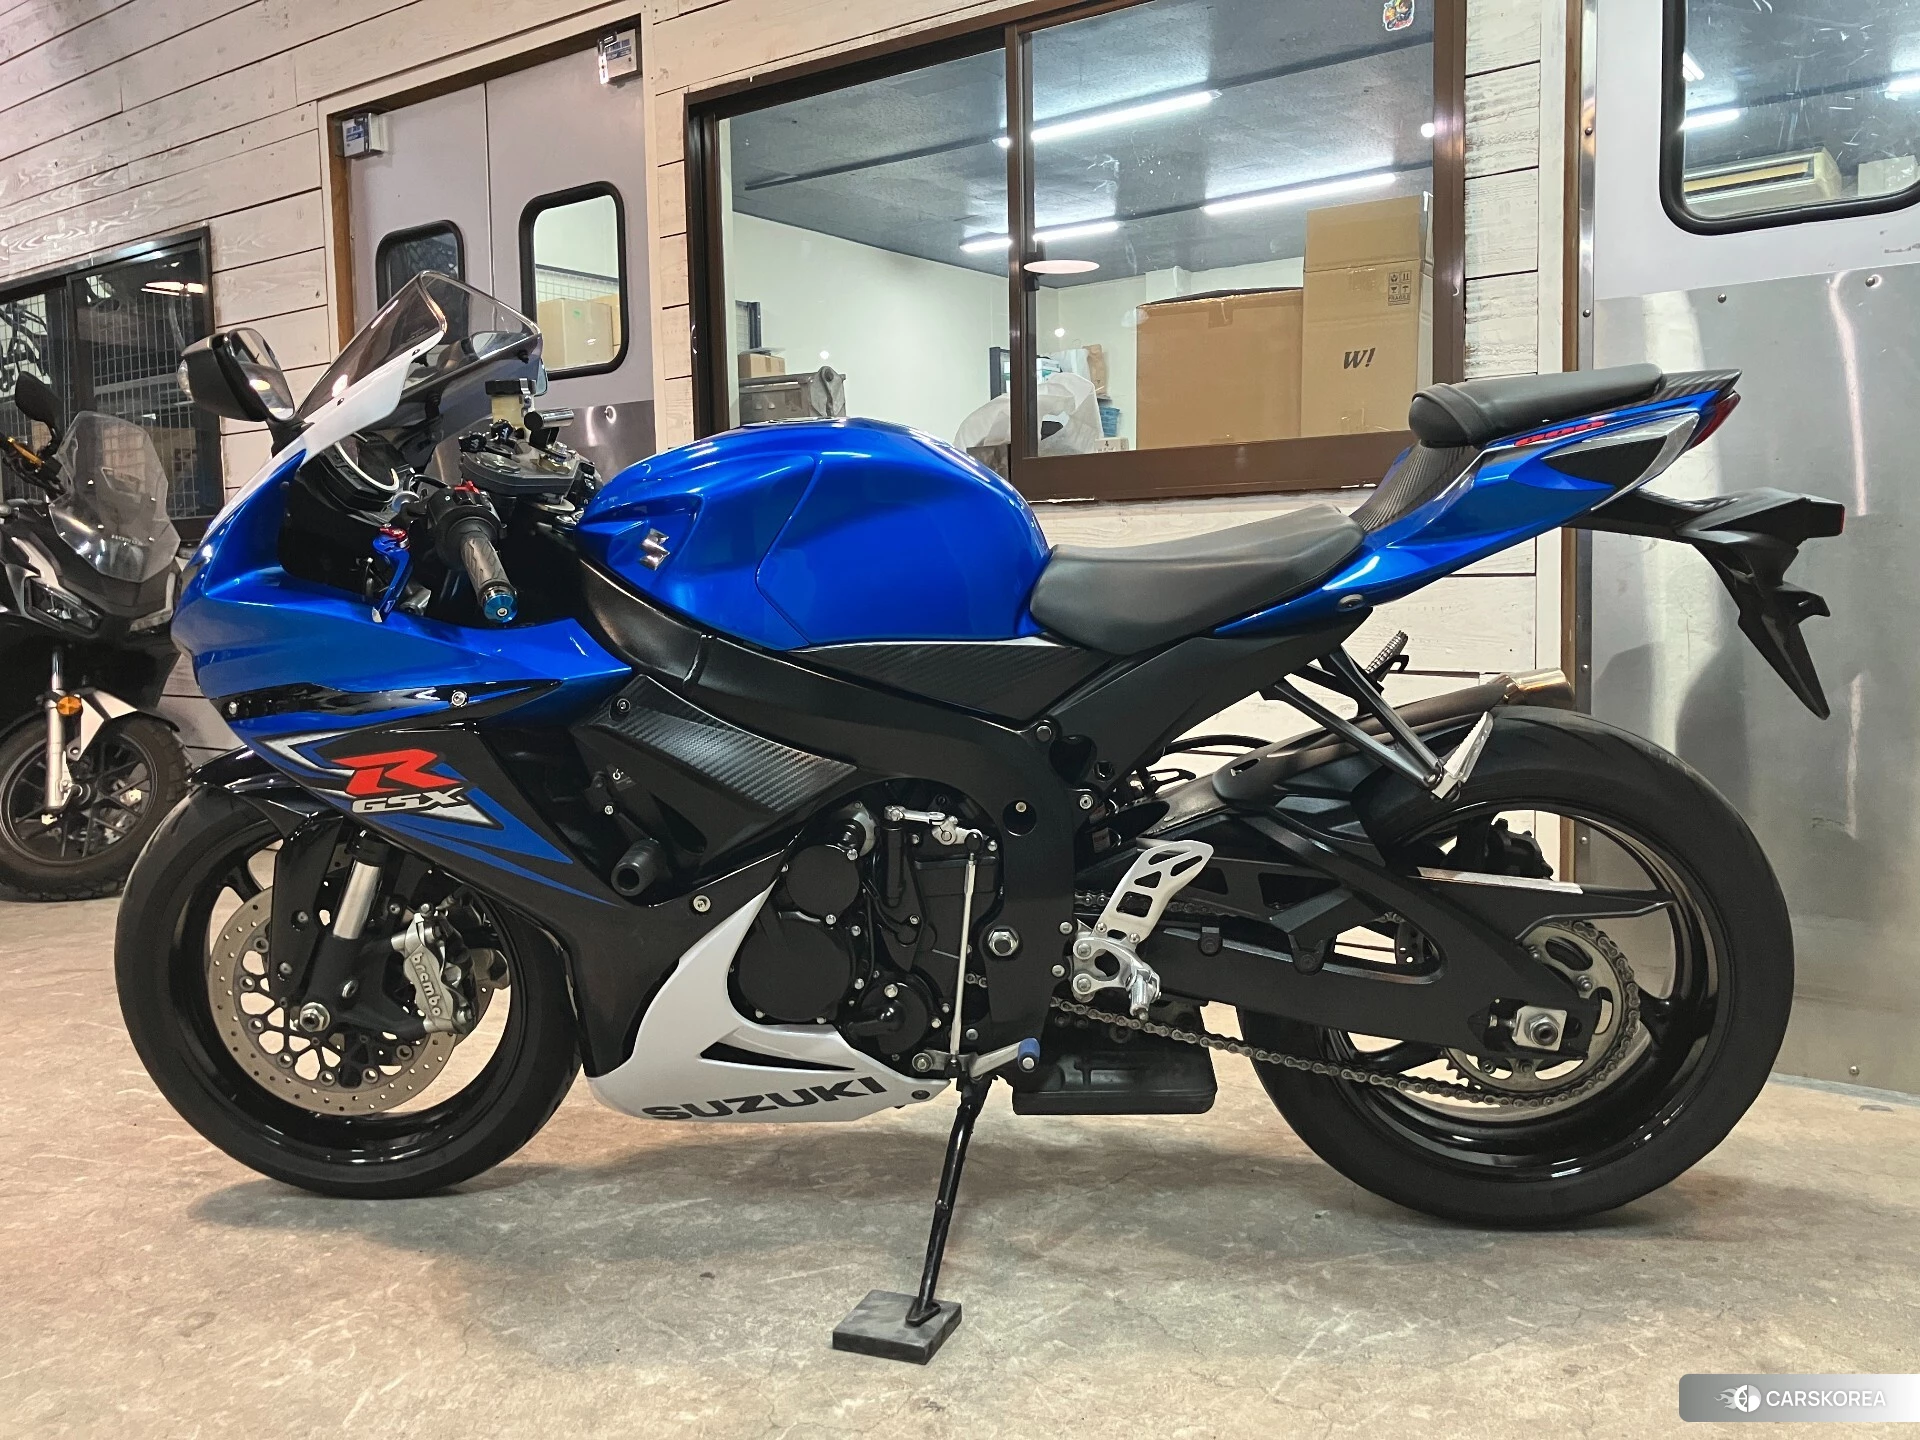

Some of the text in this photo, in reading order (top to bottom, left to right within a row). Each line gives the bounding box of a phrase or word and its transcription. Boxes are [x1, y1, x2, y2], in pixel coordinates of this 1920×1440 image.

[1343, 347, 1376, 370] W!
[330, 748, 462, 797] R
[351, 786, 465, 814] GSX
[411, 952, 442, 1017] brembo
[641, 1076, 888, 1121] SUZUKI
